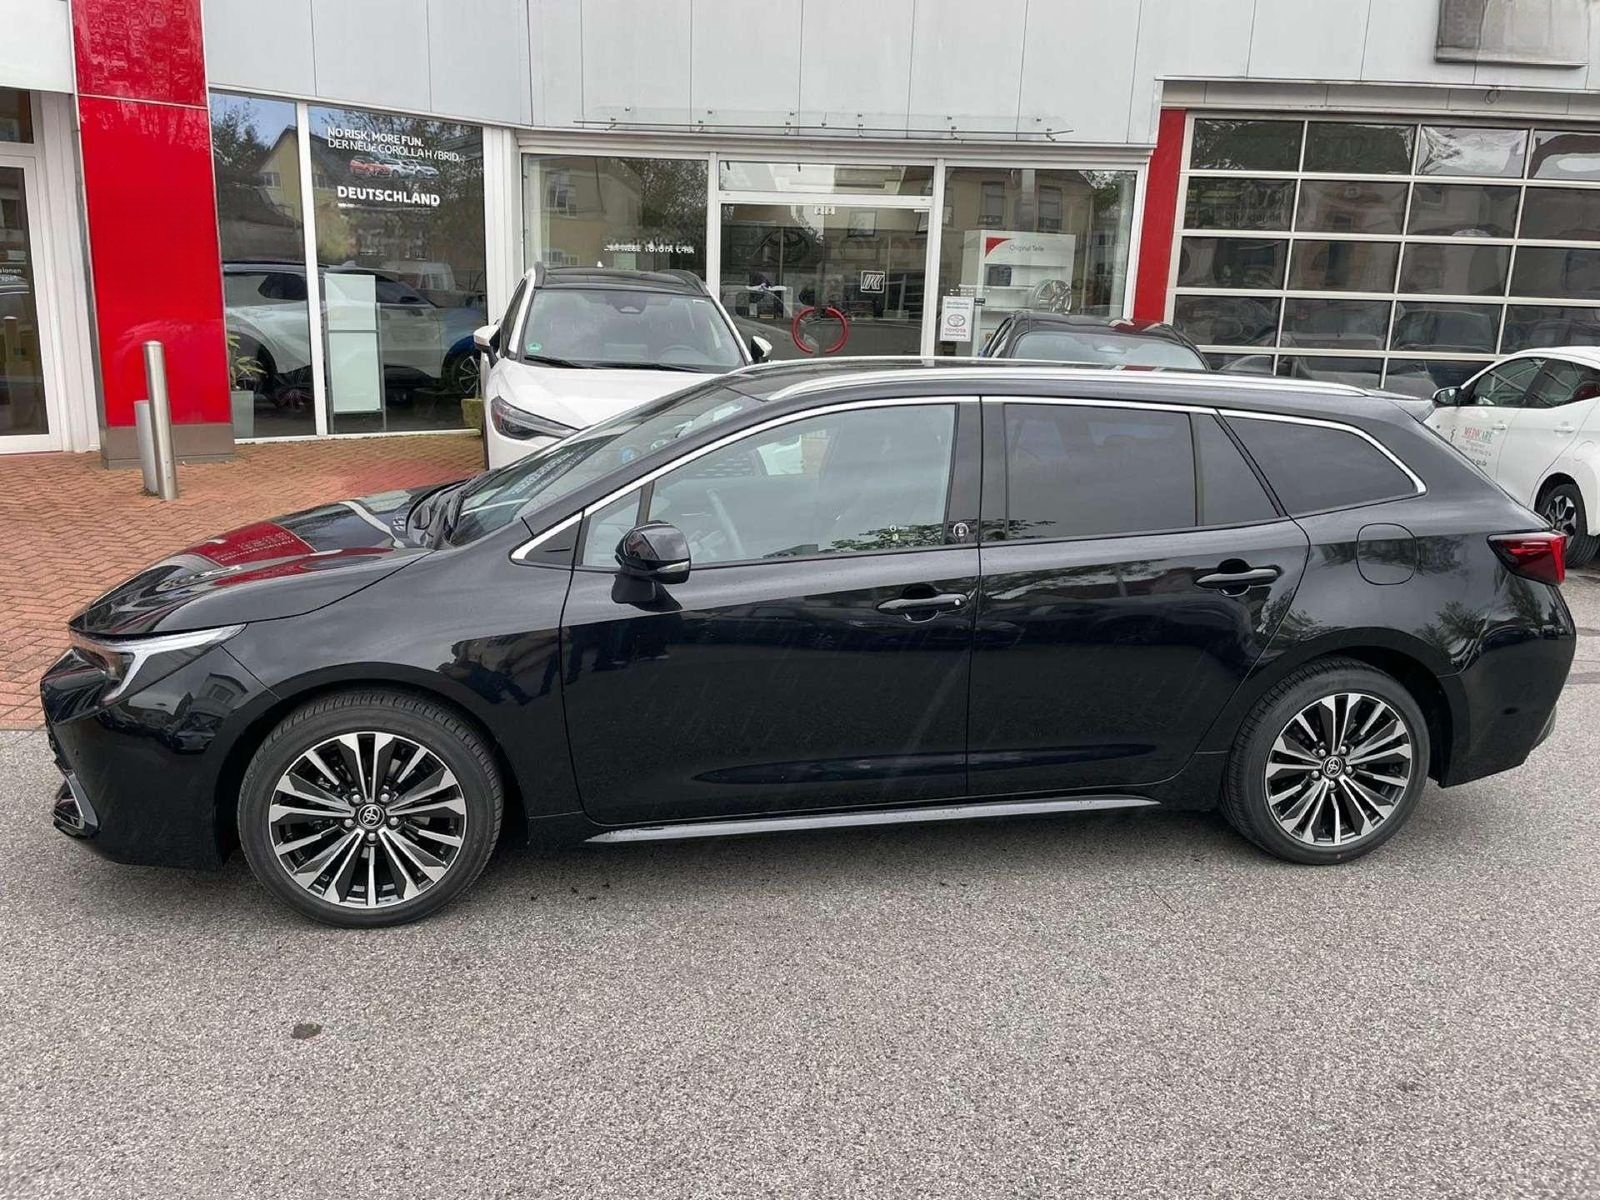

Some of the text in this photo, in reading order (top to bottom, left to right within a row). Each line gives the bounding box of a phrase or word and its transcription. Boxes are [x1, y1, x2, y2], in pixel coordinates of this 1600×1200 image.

[328, 127, 424, 147] NO RISK, MORE FUN.
[328, 138, 349, 149] DER
[351, 141, 377, 152] NEUE
[379, 144, 424, 158] COROLLA
[337, 186, 440, 207] DEUTSCHLAND
